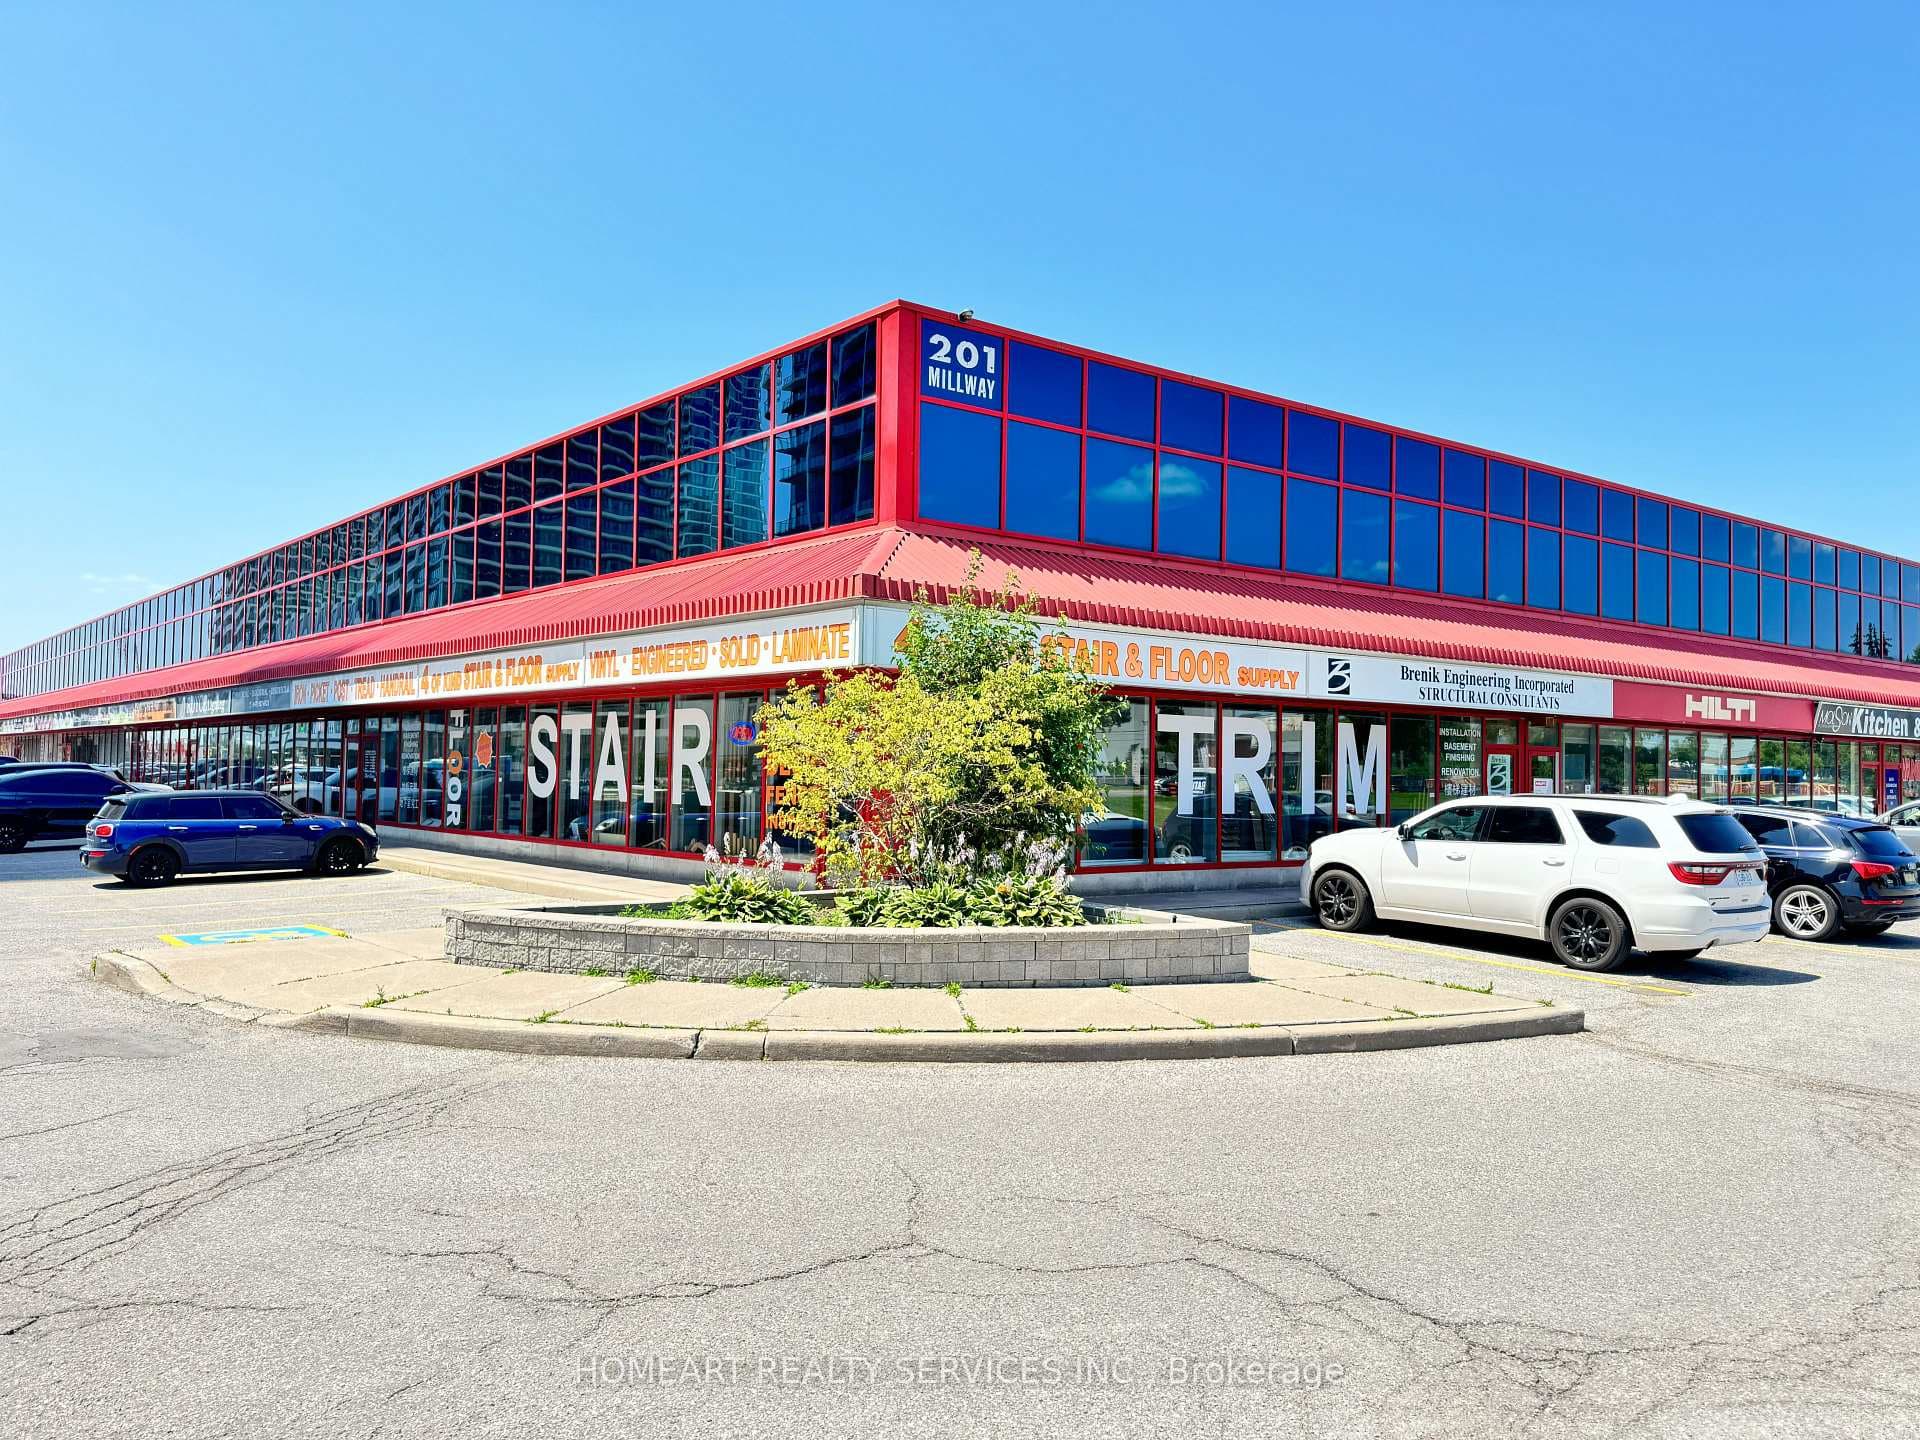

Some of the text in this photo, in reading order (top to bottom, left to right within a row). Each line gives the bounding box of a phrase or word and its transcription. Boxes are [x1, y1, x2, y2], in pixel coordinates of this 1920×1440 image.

[929, 333, 996, 374] 201
[928, 365, 995, 400] MILLWAY
[589, 622, 850, 679] VINYL ENGINEERED SOLID LAMINATE
[1125, 642, 1143, 677] &
[1149, 646, 1230, 686] FLOOR
[1237, 667, 1300, 690] SUPPLY
[379, 671, 416, 697] HANDRAIL
[420, 664, 429, 695] 4
[463, 660, 493, 690] STAIR
[505, 654, 543, 686] FLOOR
[546, 661, 580, 682] SUPPLY
[1400, 665, 1574, 696] Brenik Engineering Incorporated
[1419, 686, 1560, 710] STRUCTURAL CONSULTANTS
[1685, 694, 1756, 722] HILTI
[1440, 727, 1481, 738] INSTALLATION
[1852, 708, 1909, 737] Kitchen
[528, 708, 712, 807] STAIR
[1443, 742, 1477, 751] BASEMENT
[1445, 753, 1476, 762] FINISHING
[446, 709, 465, 826] FLOOR
[1157, 713, 1387, 815] TRIM
